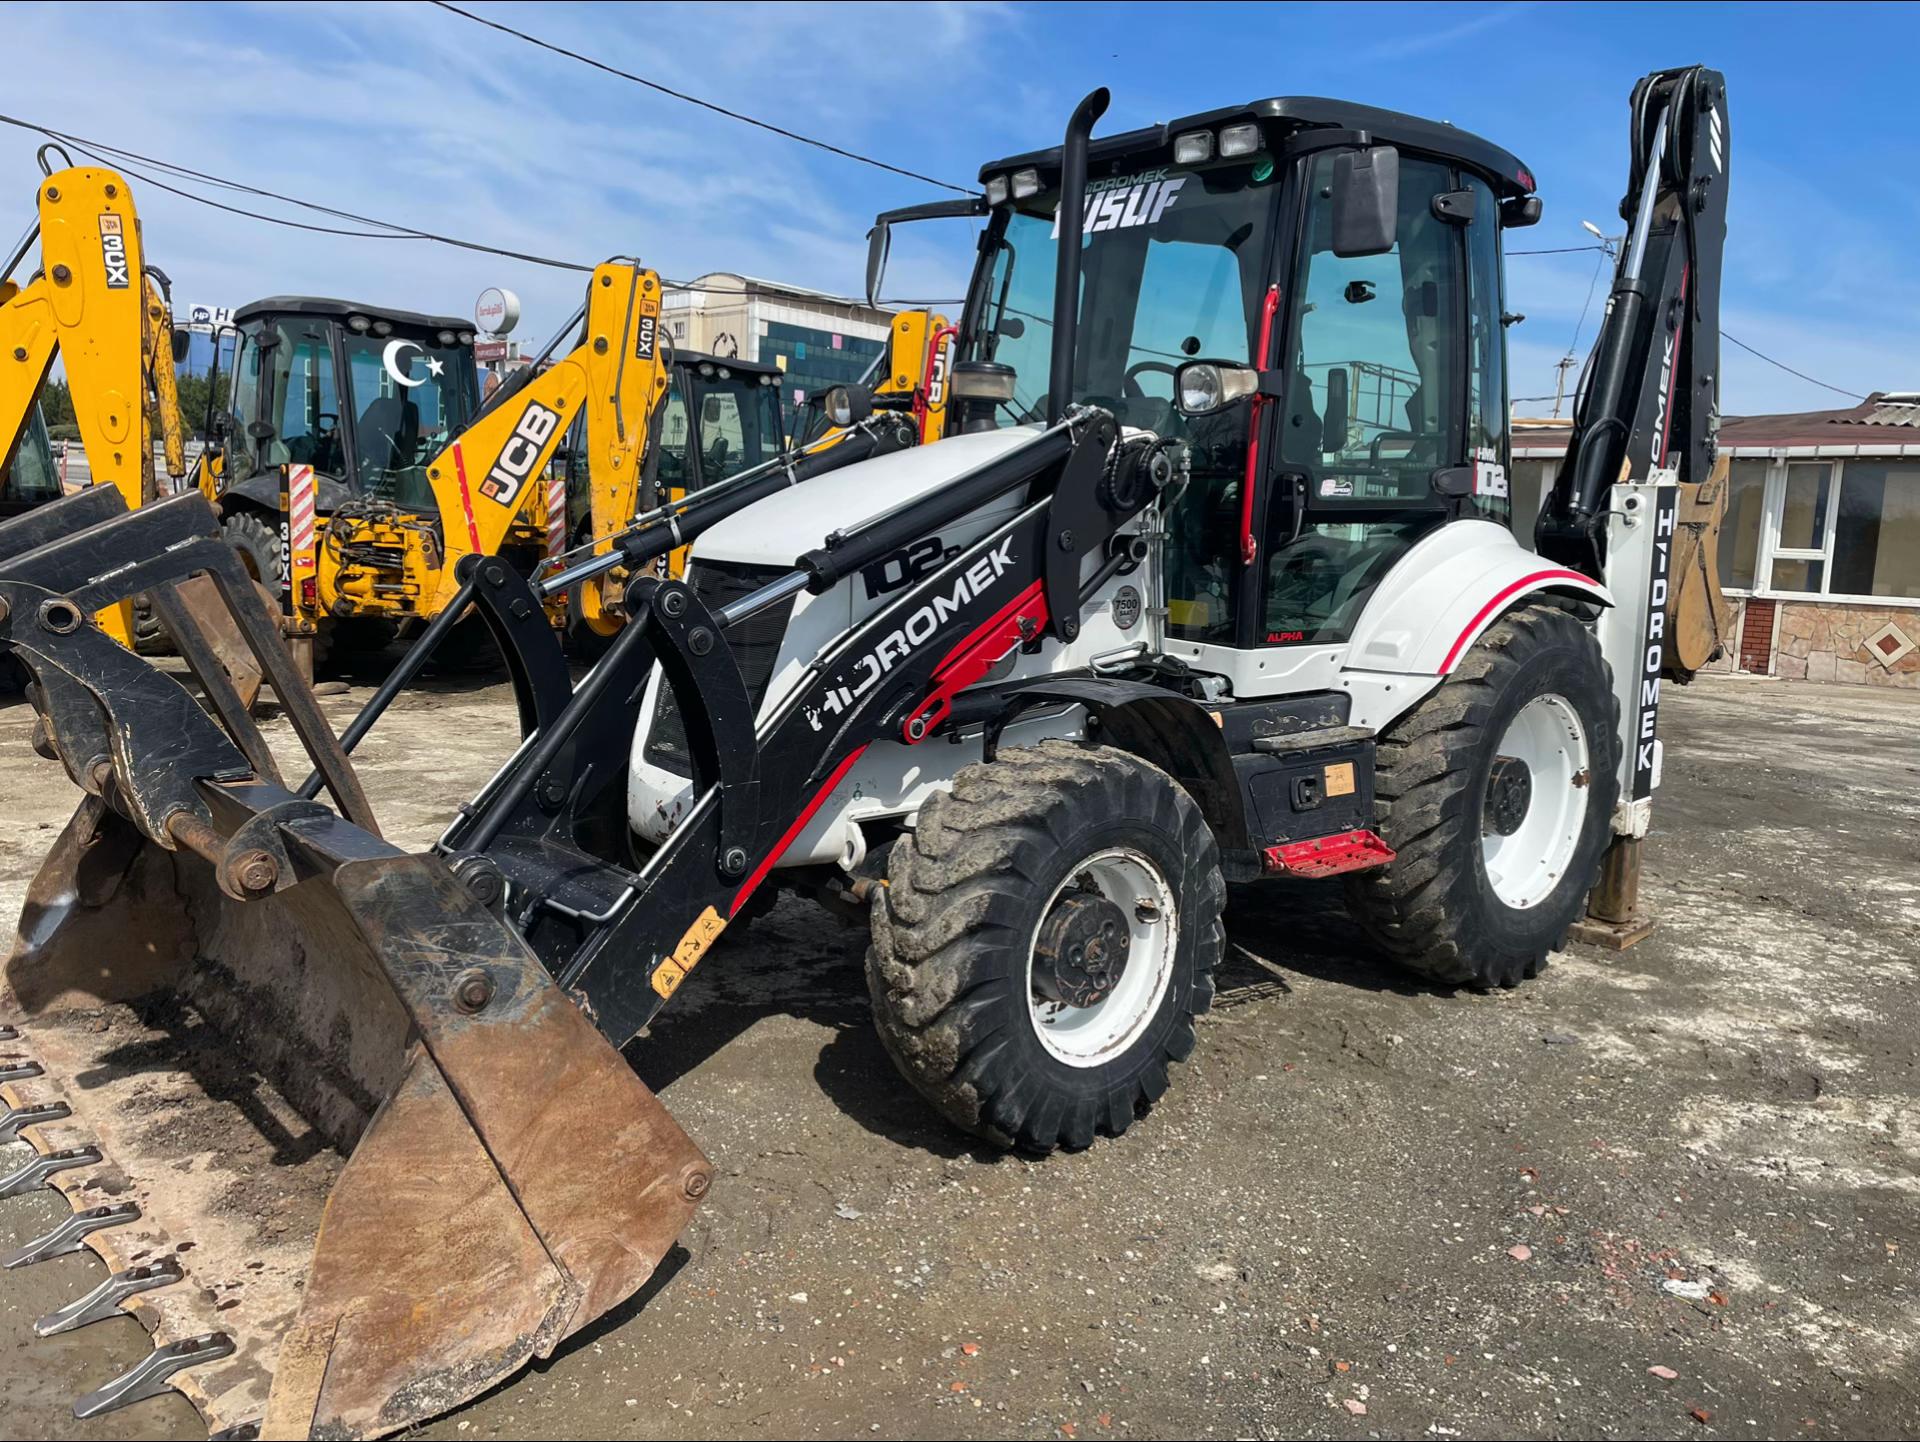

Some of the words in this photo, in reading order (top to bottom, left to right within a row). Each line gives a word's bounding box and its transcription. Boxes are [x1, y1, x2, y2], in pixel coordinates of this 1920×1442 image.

[103, 234, 129, 283] 3CX
[639, 319, 654, 354] 3CX
[1650, 335, 1674, 470] OMEK
[490, 404, 557, 504] JCB
[280, 522, 290, 581] 3CX
[1114, 599, 1138, 610] 7500
[1265, 631, 1304, 643] ALPHA
